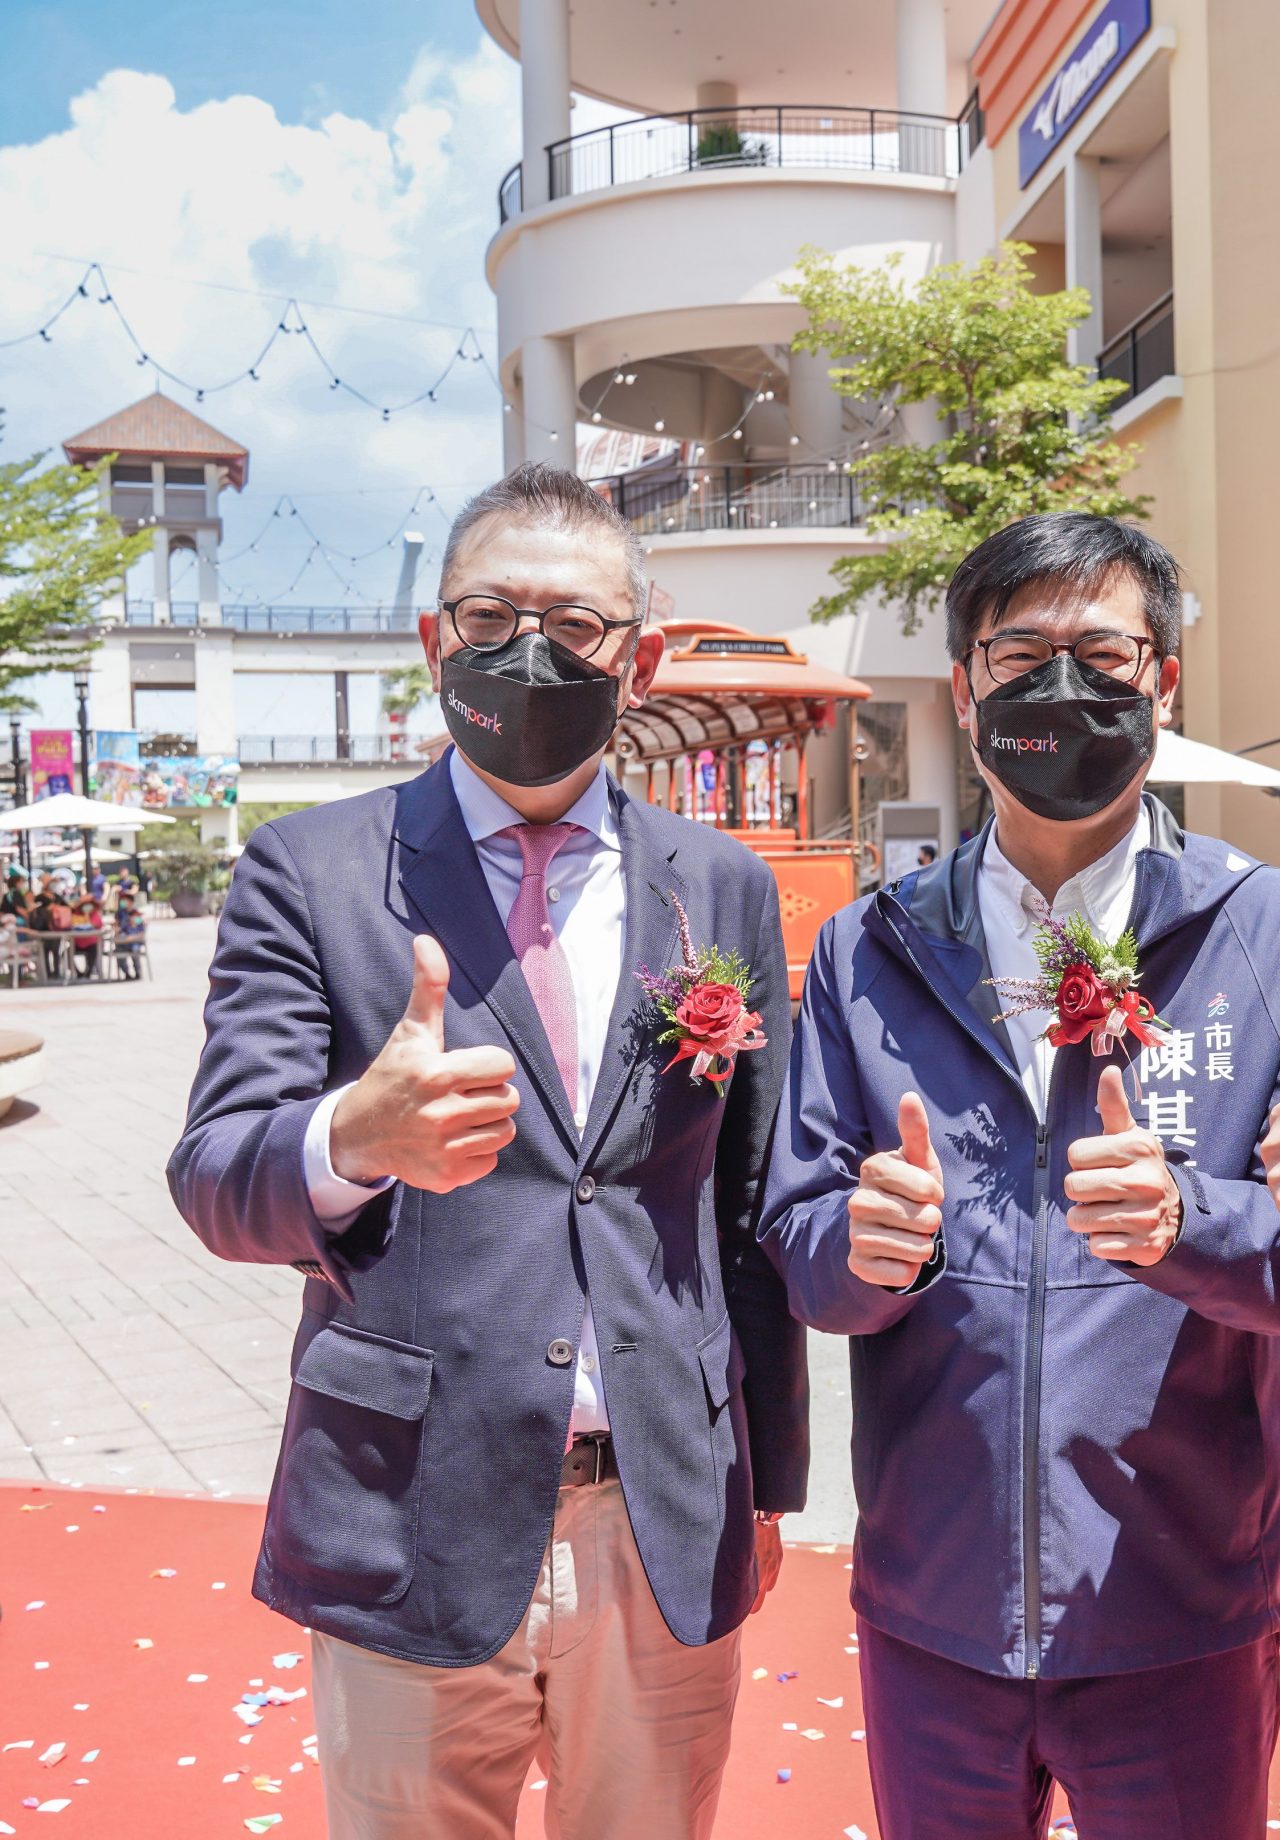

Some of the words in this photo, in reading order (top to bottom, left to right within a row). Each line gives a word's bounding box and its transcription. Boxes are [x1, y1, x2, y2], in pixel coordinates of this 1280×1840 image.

[447, 688, 503, 736] skmpark
[990, 727, 1059, 756] skmpark
[1203, 1021, 1235, 1082] 市長
[1140, 1029, 1197, 1167] 陳其
